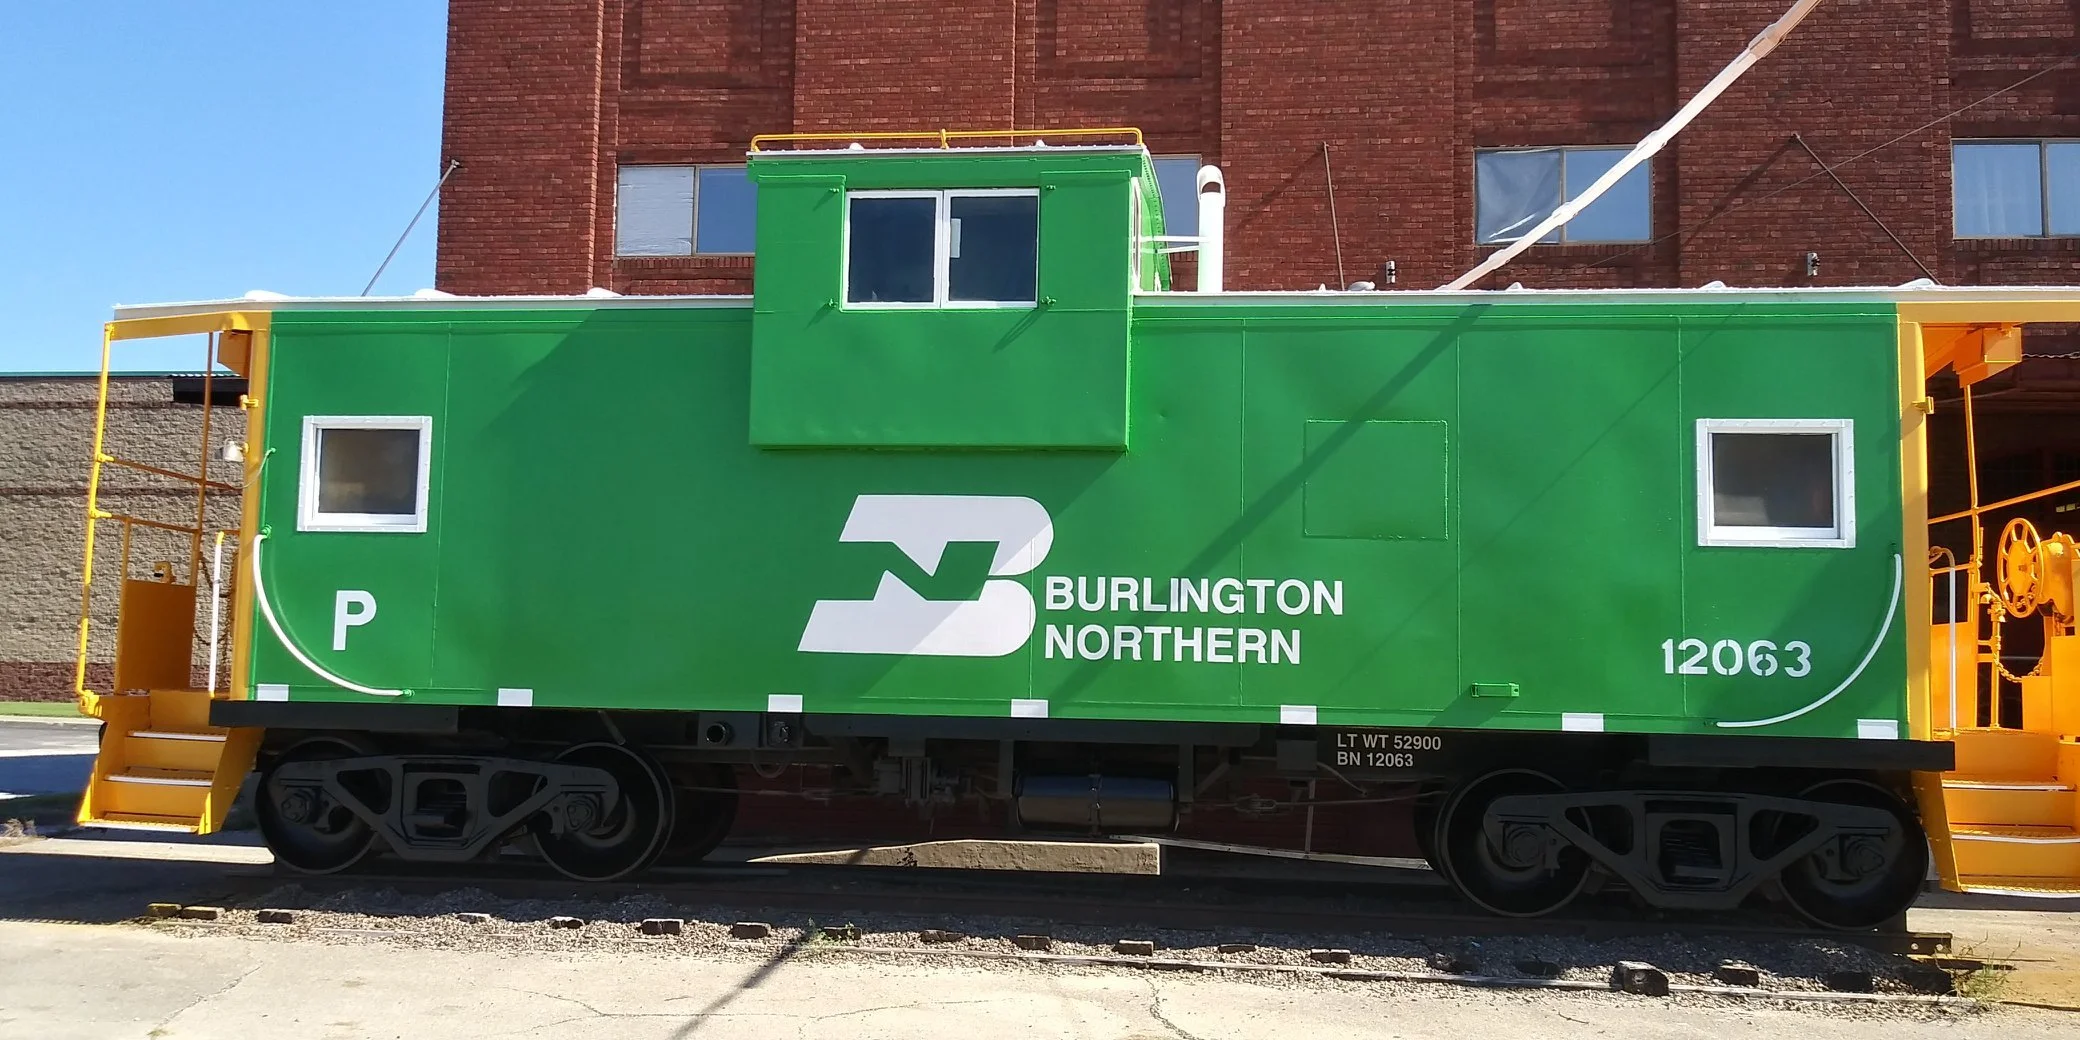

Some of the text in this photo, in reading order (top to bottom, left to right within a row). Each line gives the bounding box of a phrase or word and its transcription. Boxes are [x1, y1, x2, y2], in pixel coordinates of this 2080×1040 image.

[1045, 575, 1344, 616] BURLINGTON
[332, 589, 377, 651] P
[1044, 624, 1302, 665] NORTHERN
[1660, 637, 1812, 678] 12063
[1337, 733, 1442, 750] LT WT 52900
[1337, 751, 1414, 767] BN 12063
